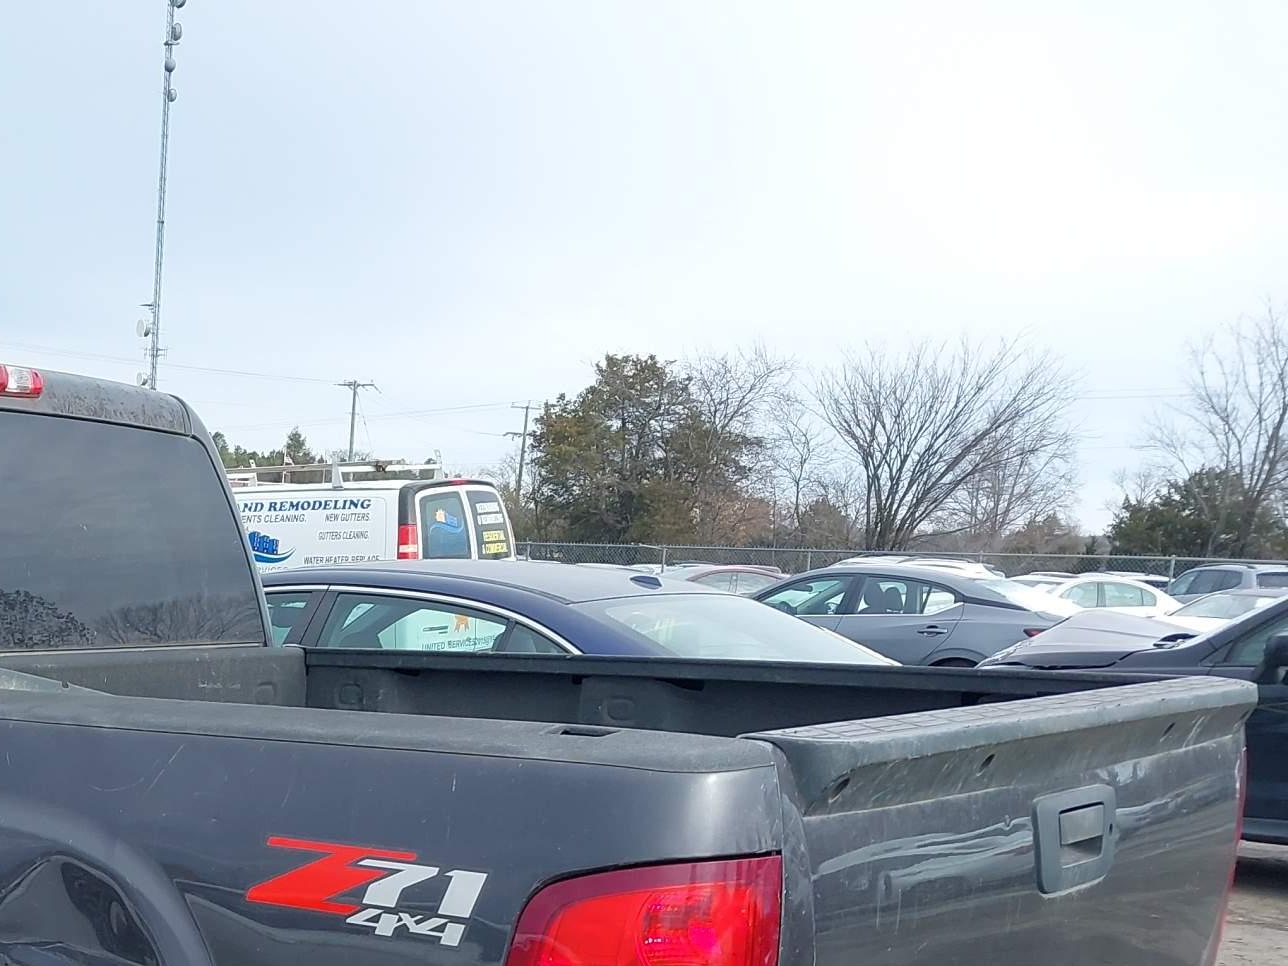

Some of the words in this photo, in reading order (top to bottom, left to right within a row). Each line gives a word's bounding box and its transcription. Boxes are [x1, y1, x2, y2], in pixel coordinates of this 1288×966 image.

[268, 499, 372, 512] REMODELING
[324, 513, 340, 522] NEW
[340, 512, 370, 522] GUTTERS
[318, 531, 342, 541] GUTTERS
[303, 556, 324, 565] WATER
[246, 836, 489, 919] Z71
